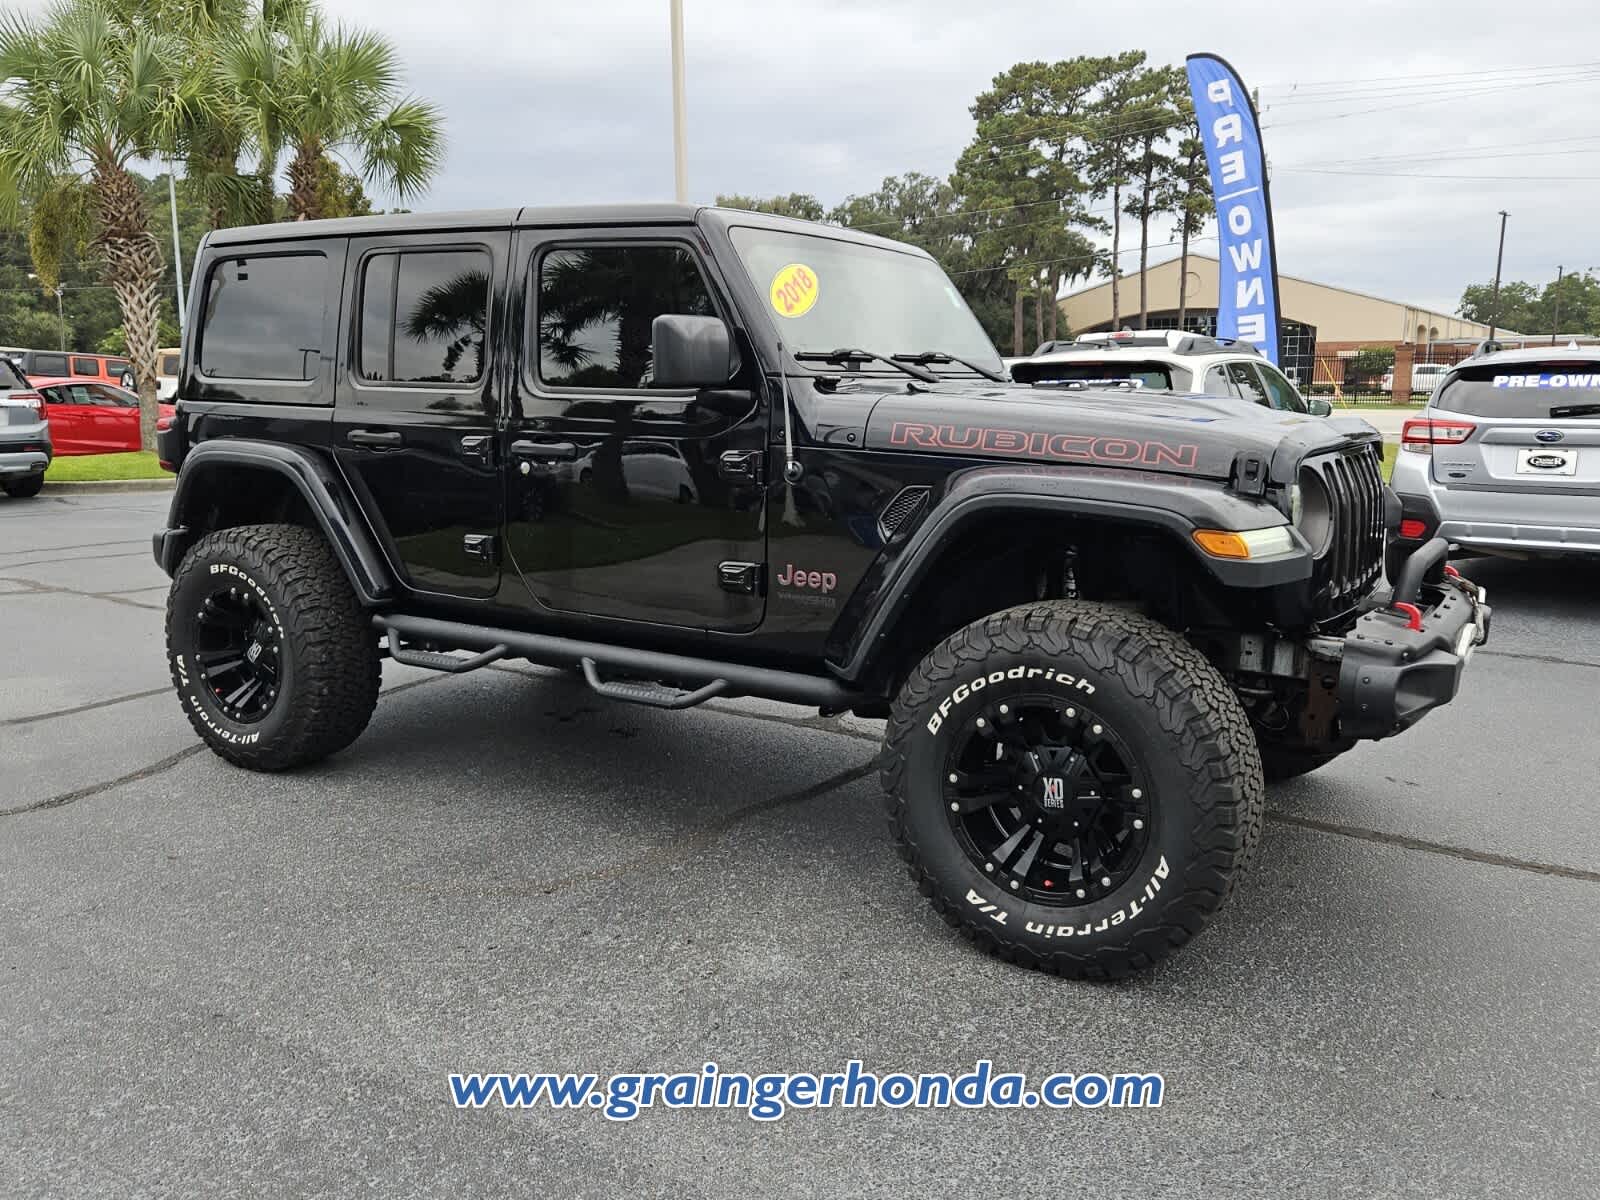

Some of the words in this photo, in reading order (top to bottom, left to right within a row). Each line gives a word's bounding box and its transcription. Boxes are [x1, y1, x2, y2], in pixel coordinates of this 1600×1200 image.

[776, 268, 813, 313] 2018
[890, 422, 1199, 468] RUBICON
[777, 564, 837, 594] Jeep
[210, 564, 284, 639] BFGoodrich
[176, 654, 190, 687] T/A
[927, 666, 1096, 736] BFGoodrich
[1043, 776, 1064, 800] XD
[965, 888, 1009, 925] T/A
